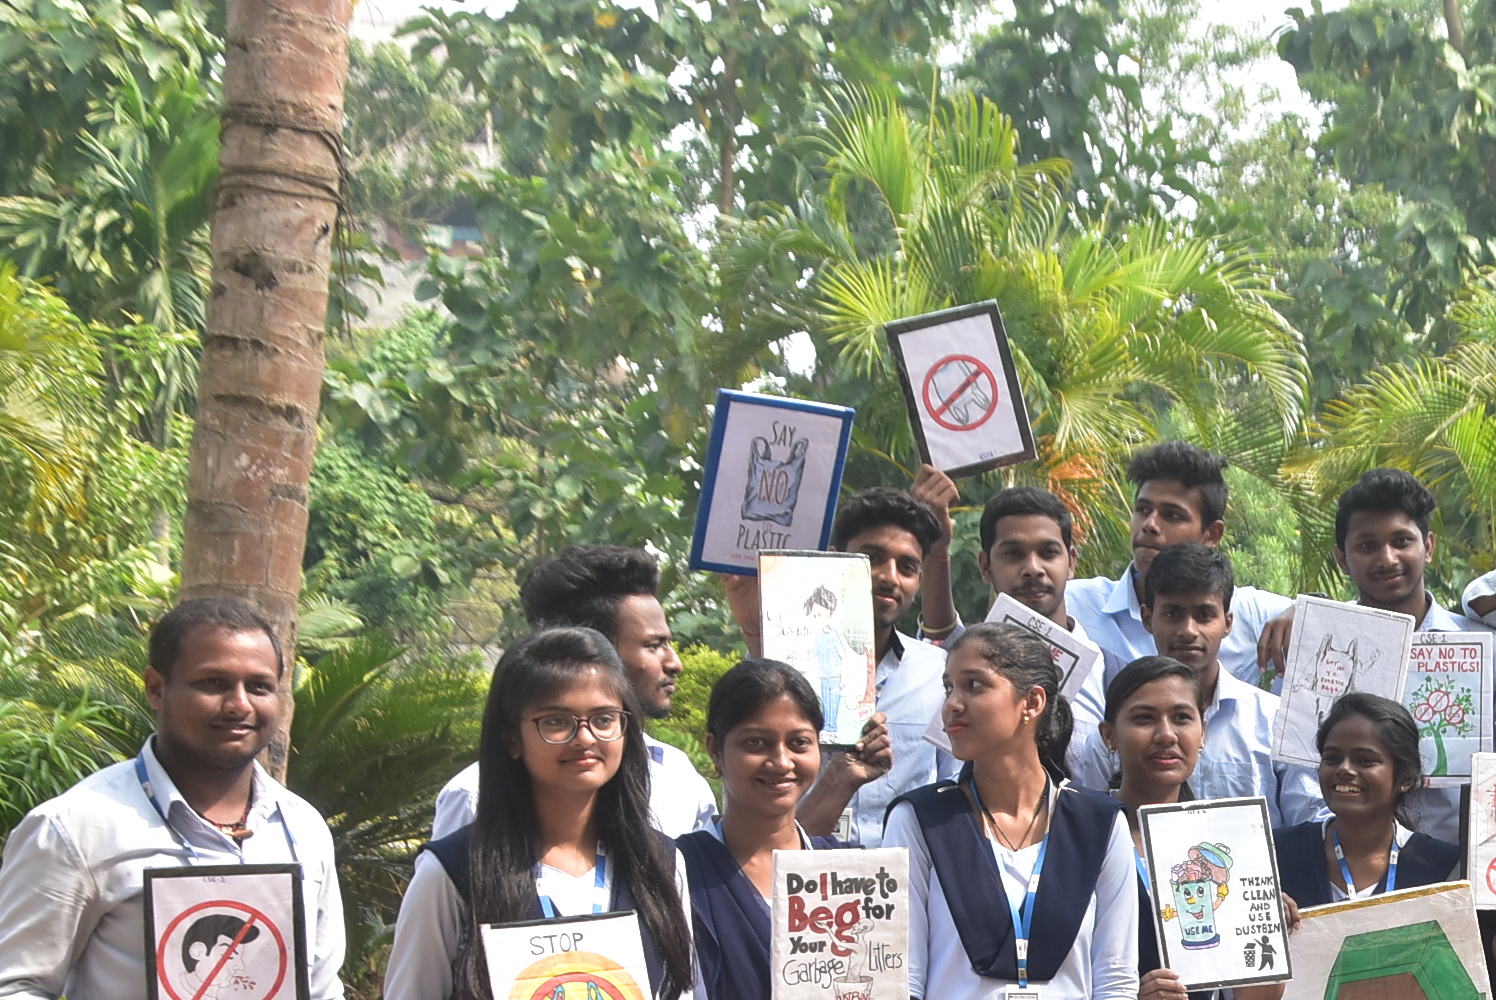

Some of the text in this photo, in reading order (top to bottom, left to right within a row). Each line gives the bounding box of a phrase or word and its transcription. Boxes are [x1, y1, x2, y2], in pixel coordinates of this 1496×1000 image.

[769, 420, 797, 448] SAY
[758, 468, 790, 506] NO
[736, 524, 791, 549] PLASTIC
[1410, 648, 1478, 660] SAY NO TO
[786, 866, 898, 901] Do I have to
[1239, 876, 1274, 888] THINK
[1242, 889, 1276, 901] CLEAN
[1250, 903, 1271, 912] AND
[788, 895, 895, 957] Beg for
[1248, 913, 1272, 922] USE
[1184, 924, 1214, 936] USE ME
[1235, 922, 1281, 937] DUSTBIN
[530, 932, 584, 955] STOP
[789, 936, 827, 955] Your
[782, 940, 903, 989] Garbage Litters
